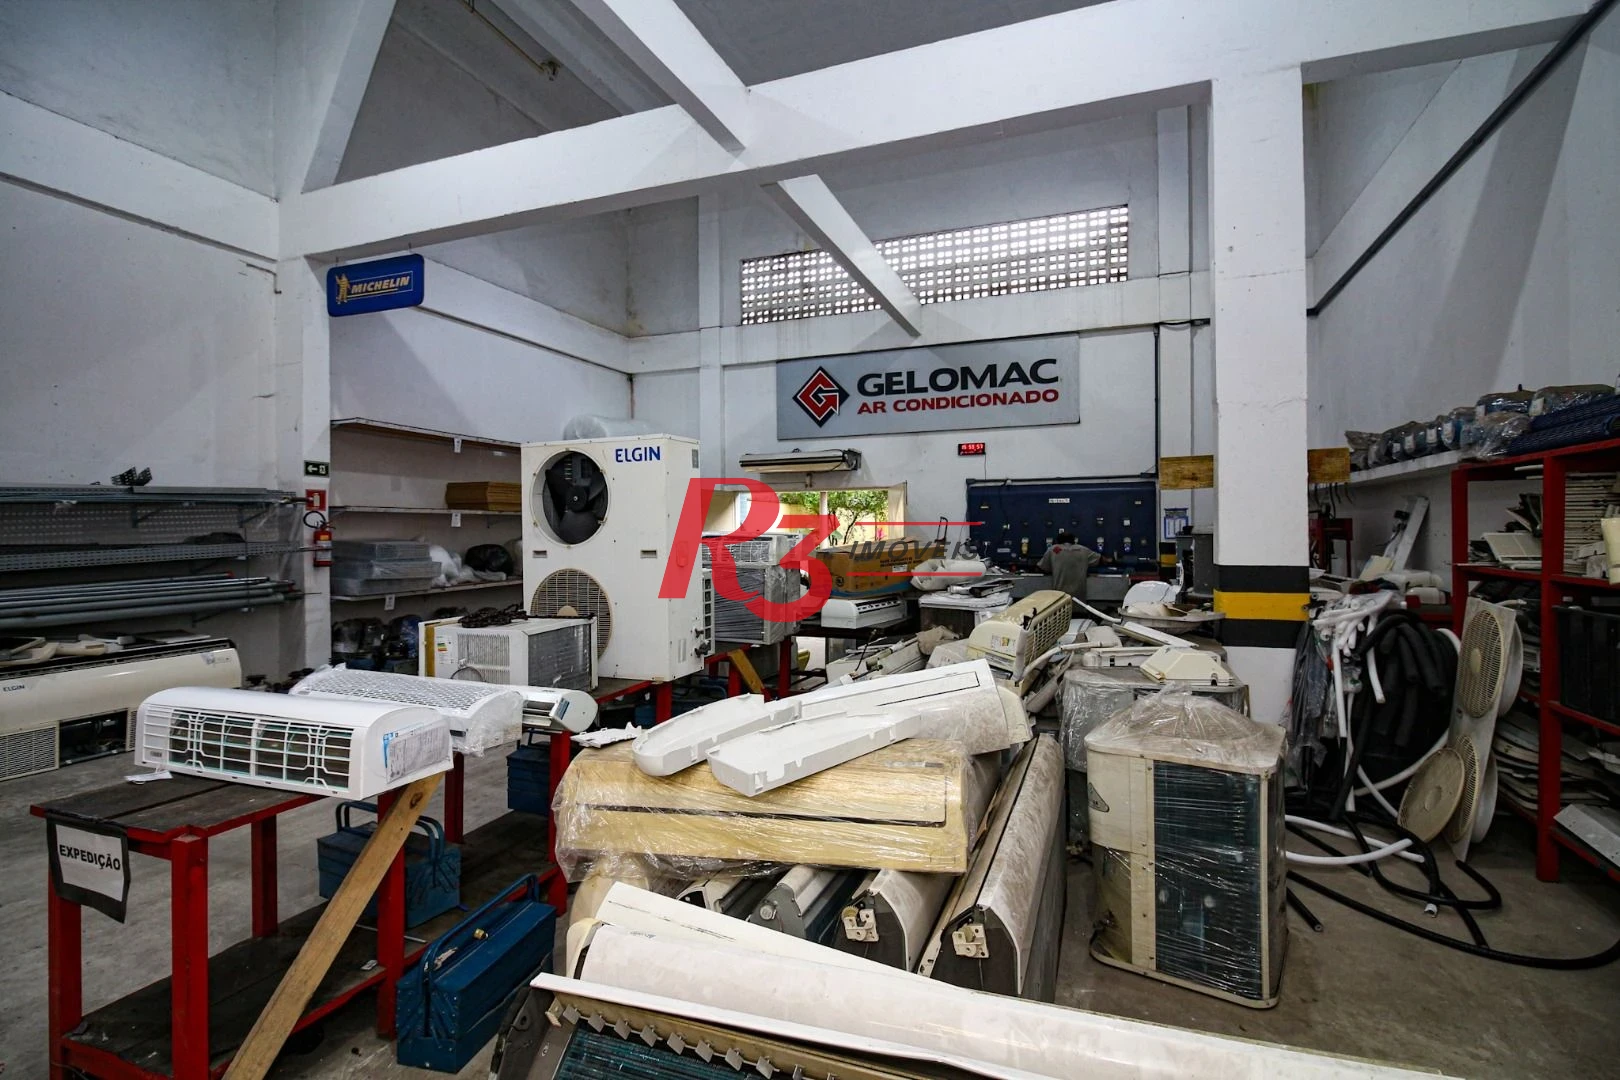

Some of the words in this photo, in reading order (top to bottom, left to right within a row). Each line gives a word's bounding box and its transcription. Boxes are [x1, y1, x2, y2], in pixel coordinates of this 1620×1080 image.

[351, 275, 410, 294] MICHELIN
[856, 358, 1059, 397] GELOMAC
[857, 400, 887, 415] AR
[893, 388, 1059, 413] CONDICIONADO
[615, 445, 661, 463] ELGIN
[3, 684, 26, 693] ELGIN
[59, 844, 121, 871] EXPEDIÇÃO
